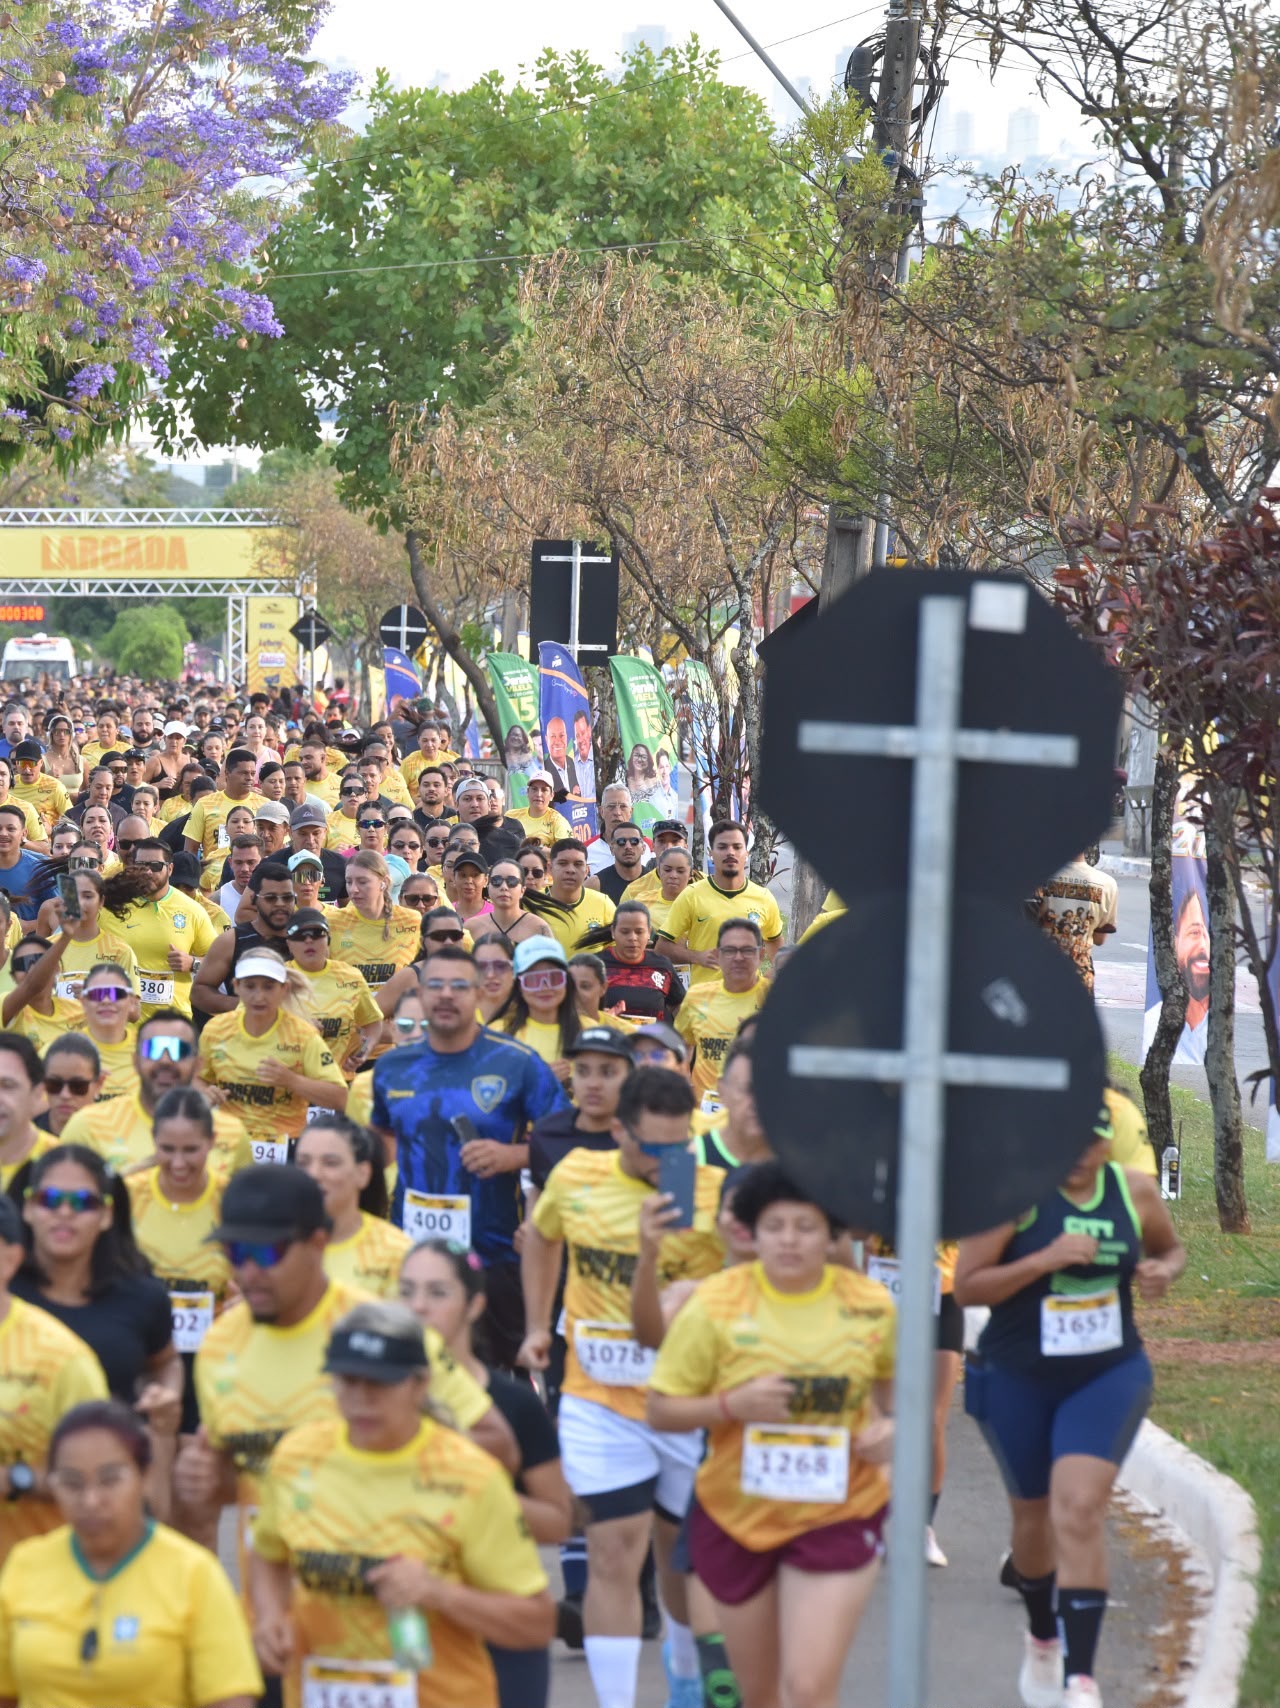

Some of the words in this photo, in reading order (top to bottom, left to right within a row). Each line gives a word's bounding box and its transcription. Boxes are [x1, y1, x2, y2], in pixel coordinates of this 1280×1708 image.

[42, 535, 188, 570] LARGADA
[414, 1212, 452, 1231] 400
[588, 1344, 646, 1365] 1078
[761, 1452, 831, 1476] 1268
